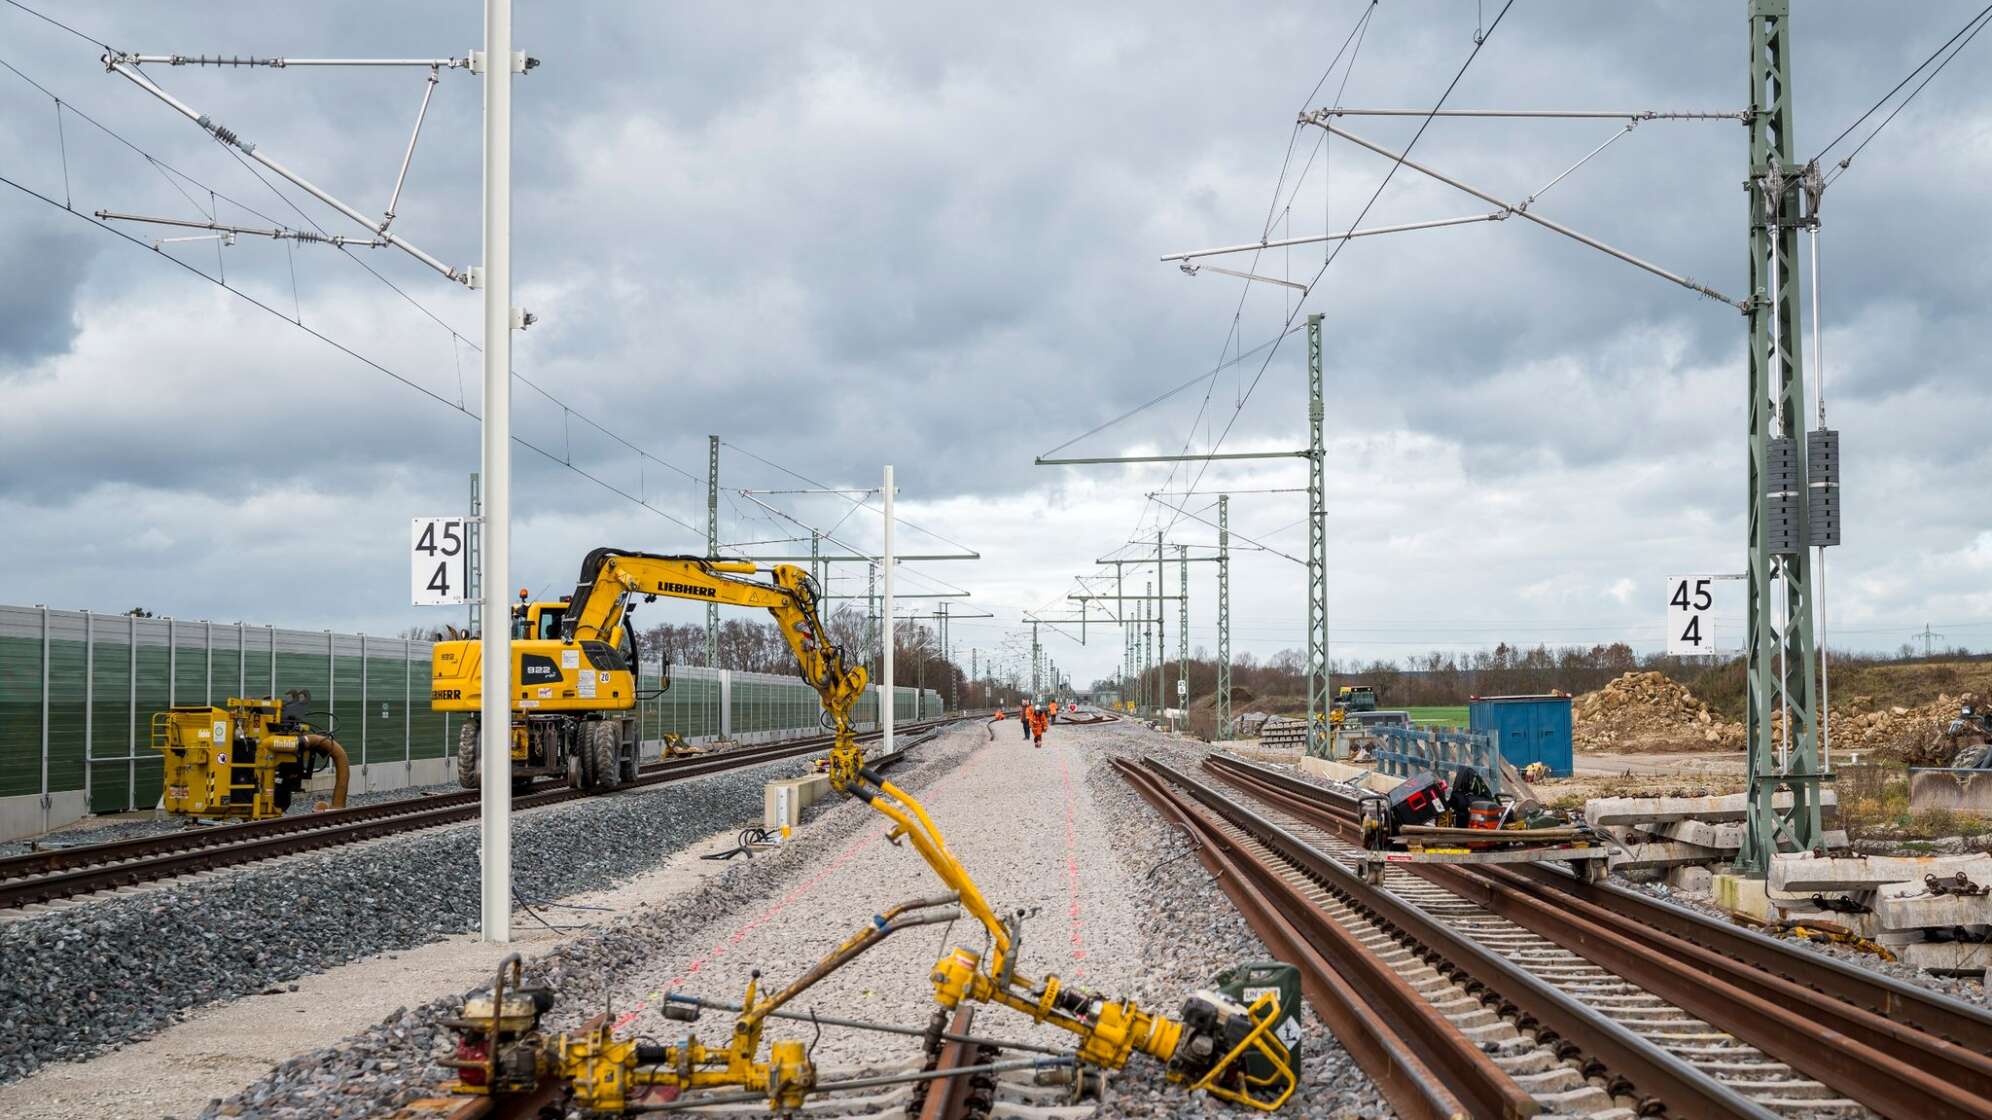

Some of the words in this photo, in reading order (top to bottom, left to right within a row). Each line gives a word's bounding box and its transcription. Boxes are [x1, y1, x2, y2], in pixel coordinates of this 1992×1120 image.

[415, 521, 462, 557] 45
[426, 561, 450, 596] 4
[657, 581, 717, 598] LIEBHERR
[1670, 580, 1712, 611] 45
[1680, 615, 1702, 646] 4
[601, 673, 610, 682] 20
